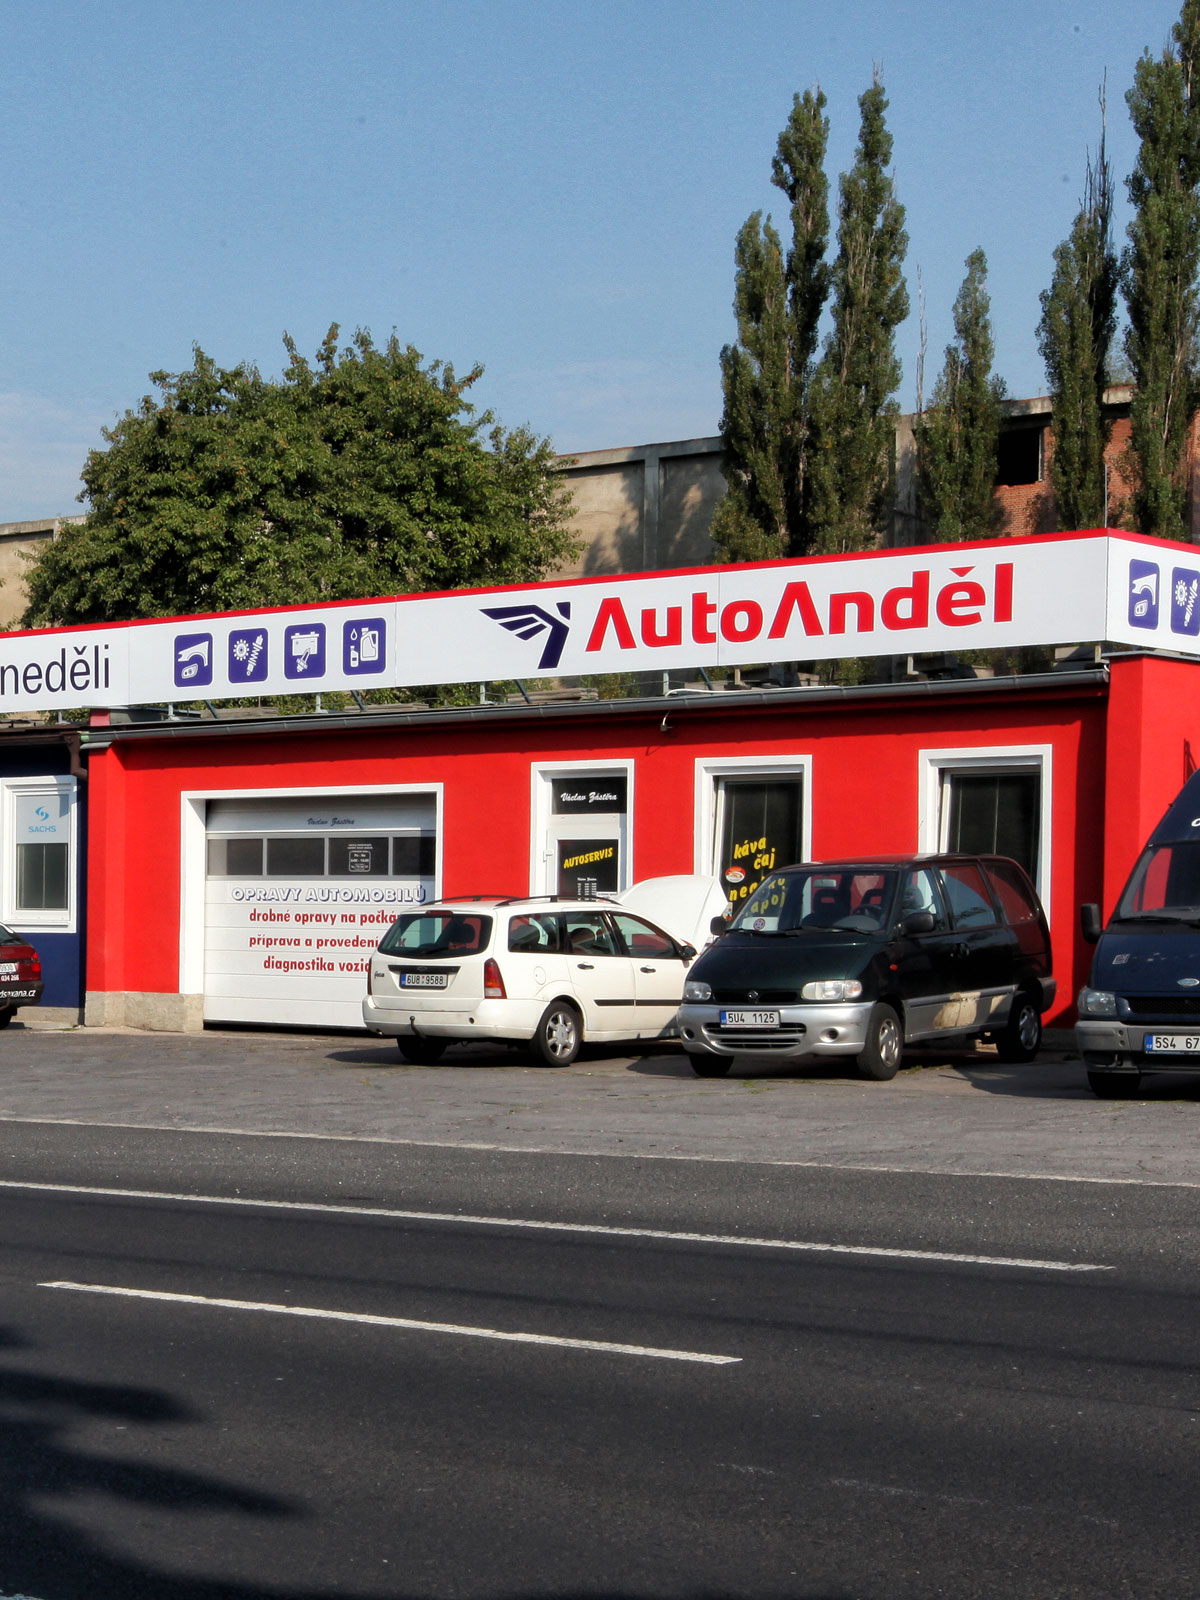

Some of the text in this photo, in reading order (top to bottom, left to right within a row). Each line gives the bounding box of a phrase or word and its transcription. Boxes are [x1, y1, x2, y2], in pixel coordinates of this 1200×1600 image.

[585, 562, 1014, 653] AutoAnděl
[0, 643, 111, 696] neděli
[28, 825, 56, 833] SACHS
[733, 836, 767, 860] káva
[563, 847, 614, 869] AUTOSERVIS
[753, 847, 776, 870] čaj
[231, 884, 427, 904] OPRAVY AUTOMOBILŮ
[249, 908, 400, 926] drobné opravy na počká
[249, 933, 379, 949] příprava a provedení
[263, 955, 335, 973] diagnostika
[406, 975, 421, 985] 6U8
[727, 1012, 775, 1023] 5U4 1125
[1155, 1037, 1176, 1049] 5S4
